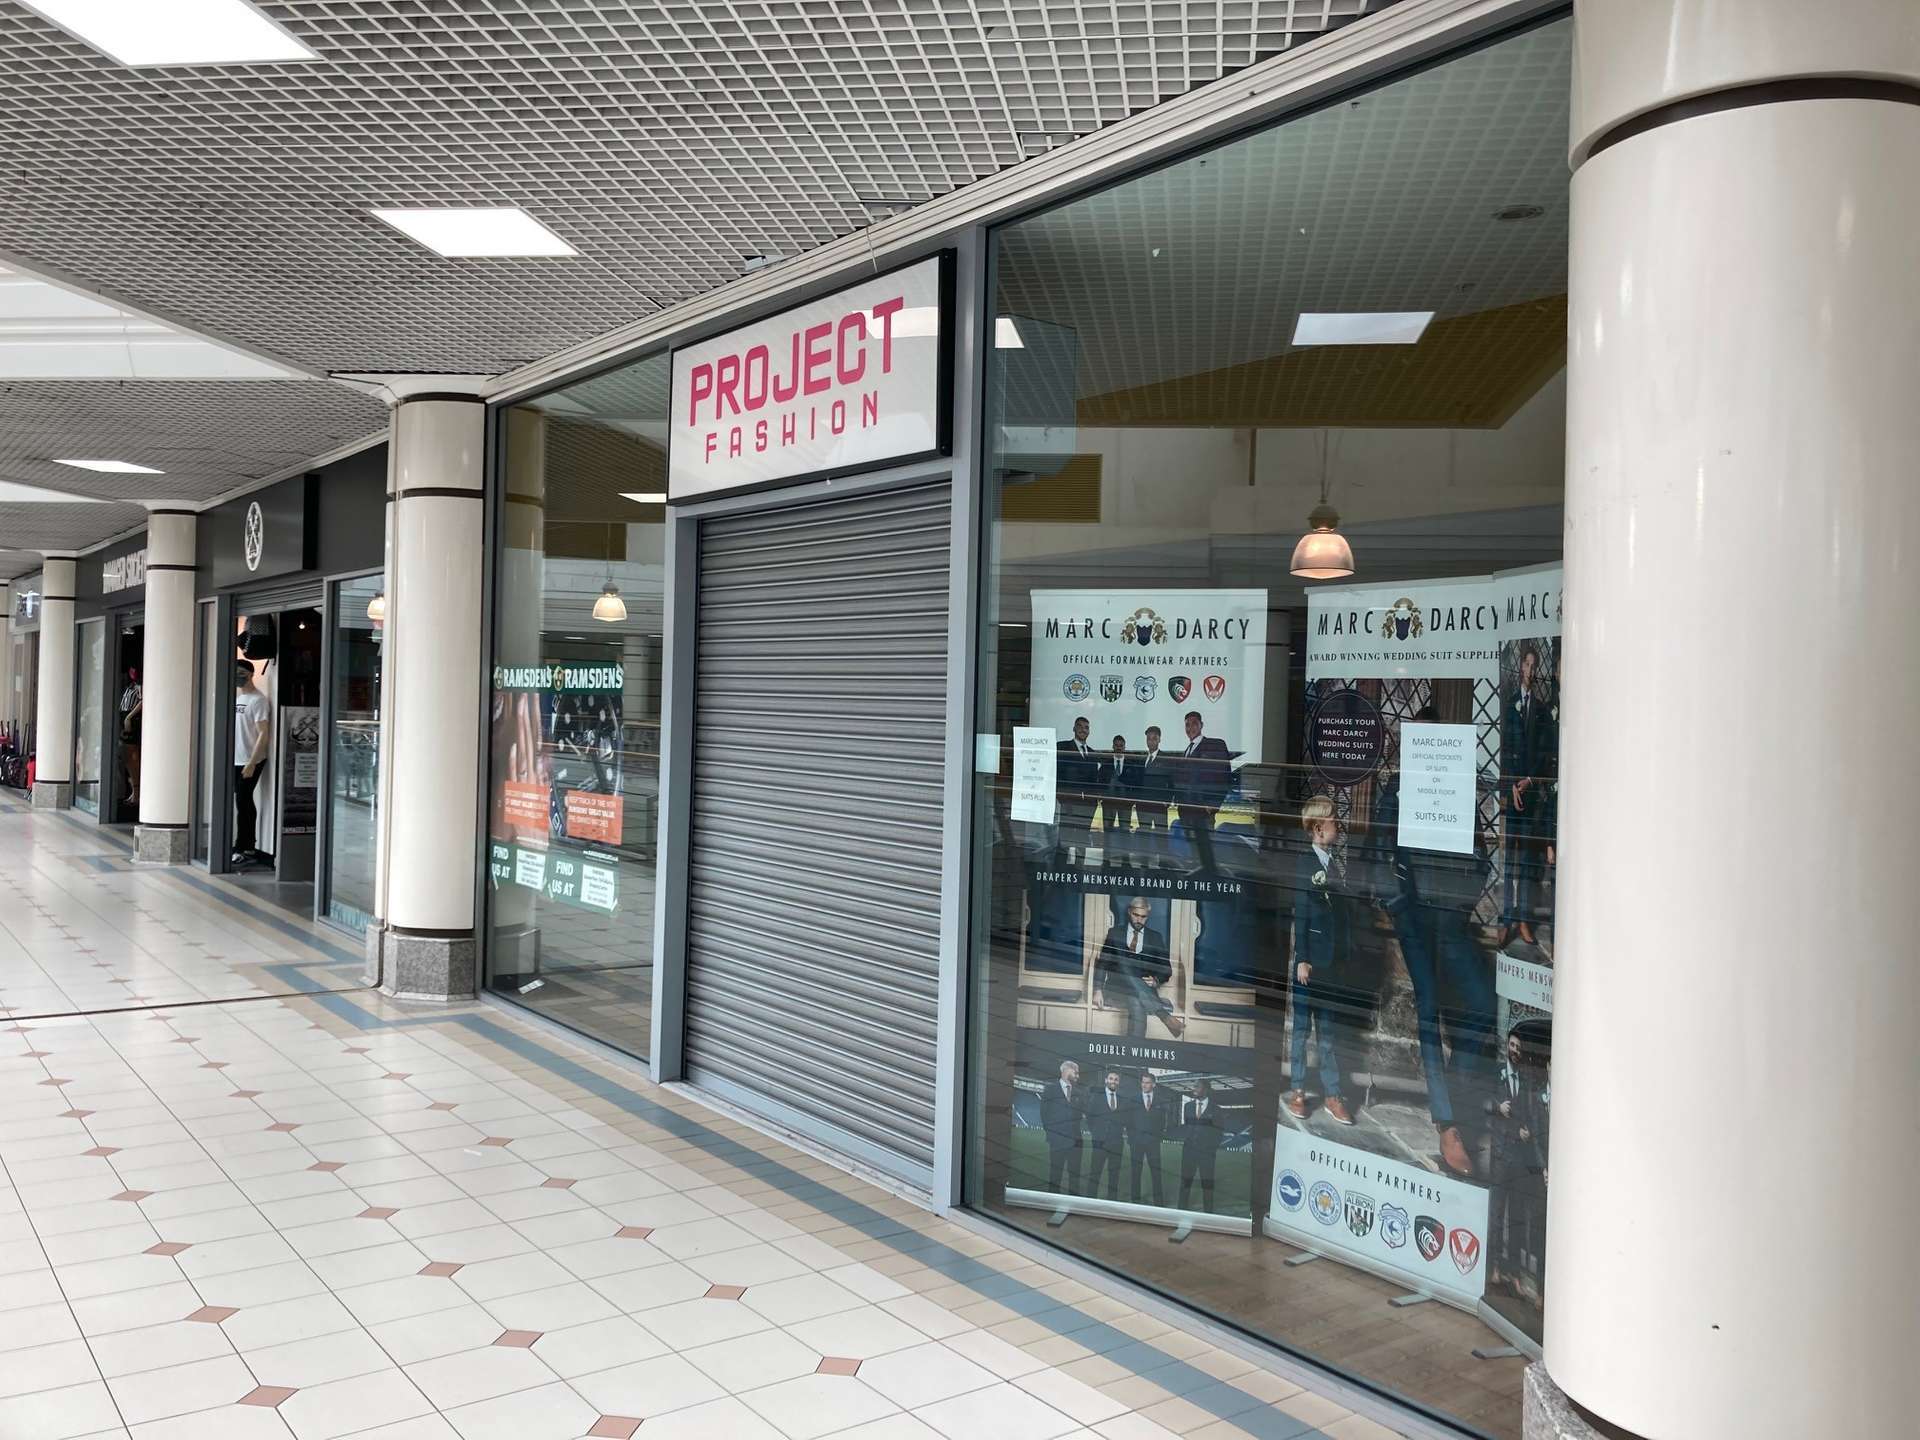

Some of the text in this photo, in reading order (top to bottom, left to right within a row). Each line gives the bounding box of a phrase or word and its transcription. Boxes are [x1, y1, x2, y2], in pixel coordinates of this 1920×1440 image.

[690, 296, 904, 427] PROJECT
[705, 390, 878, 464] FASHION
[1506, 592, 1549, 622] MARC
[1045, 618, 1250, 640] MARC DARCY
[1317, 605, 1498, 635] MARC DARCY
[1063, 654, 1228, 666] OFFICIAL FORMALWEAR PARTNERS
[1340, 652, 1380, 661] WINNING
[1383, 651, 1427, 661] WEDDING
[1430, 651, 1452, 660] SUIT
[503, 669, 552, 688] RAMSDENS
[564, 668, 624, 689] RAMSDENS
[1412, 738, 1463, 748] MARC DARCY
[1415, 811, 1457, 823] SUITS PLUS
[493, 845, 509, 860] FIND
[491, 863, 501, 876] US
[501, 865, 511, 879] AT
[556, 861, 574, 876] FIND
[552, 879, 575, 897] US AT
[1036, 872, 1242, 893] DRAPERS MENSWEAR BRAND OF THE YEAR
[1089, 1043, 1176, 1060] DOUBLE WINNERS
[1310, 1150, 1368, 1178] OFFICIAL
[1377, 1170, 1441, 1203] PARTNERS
